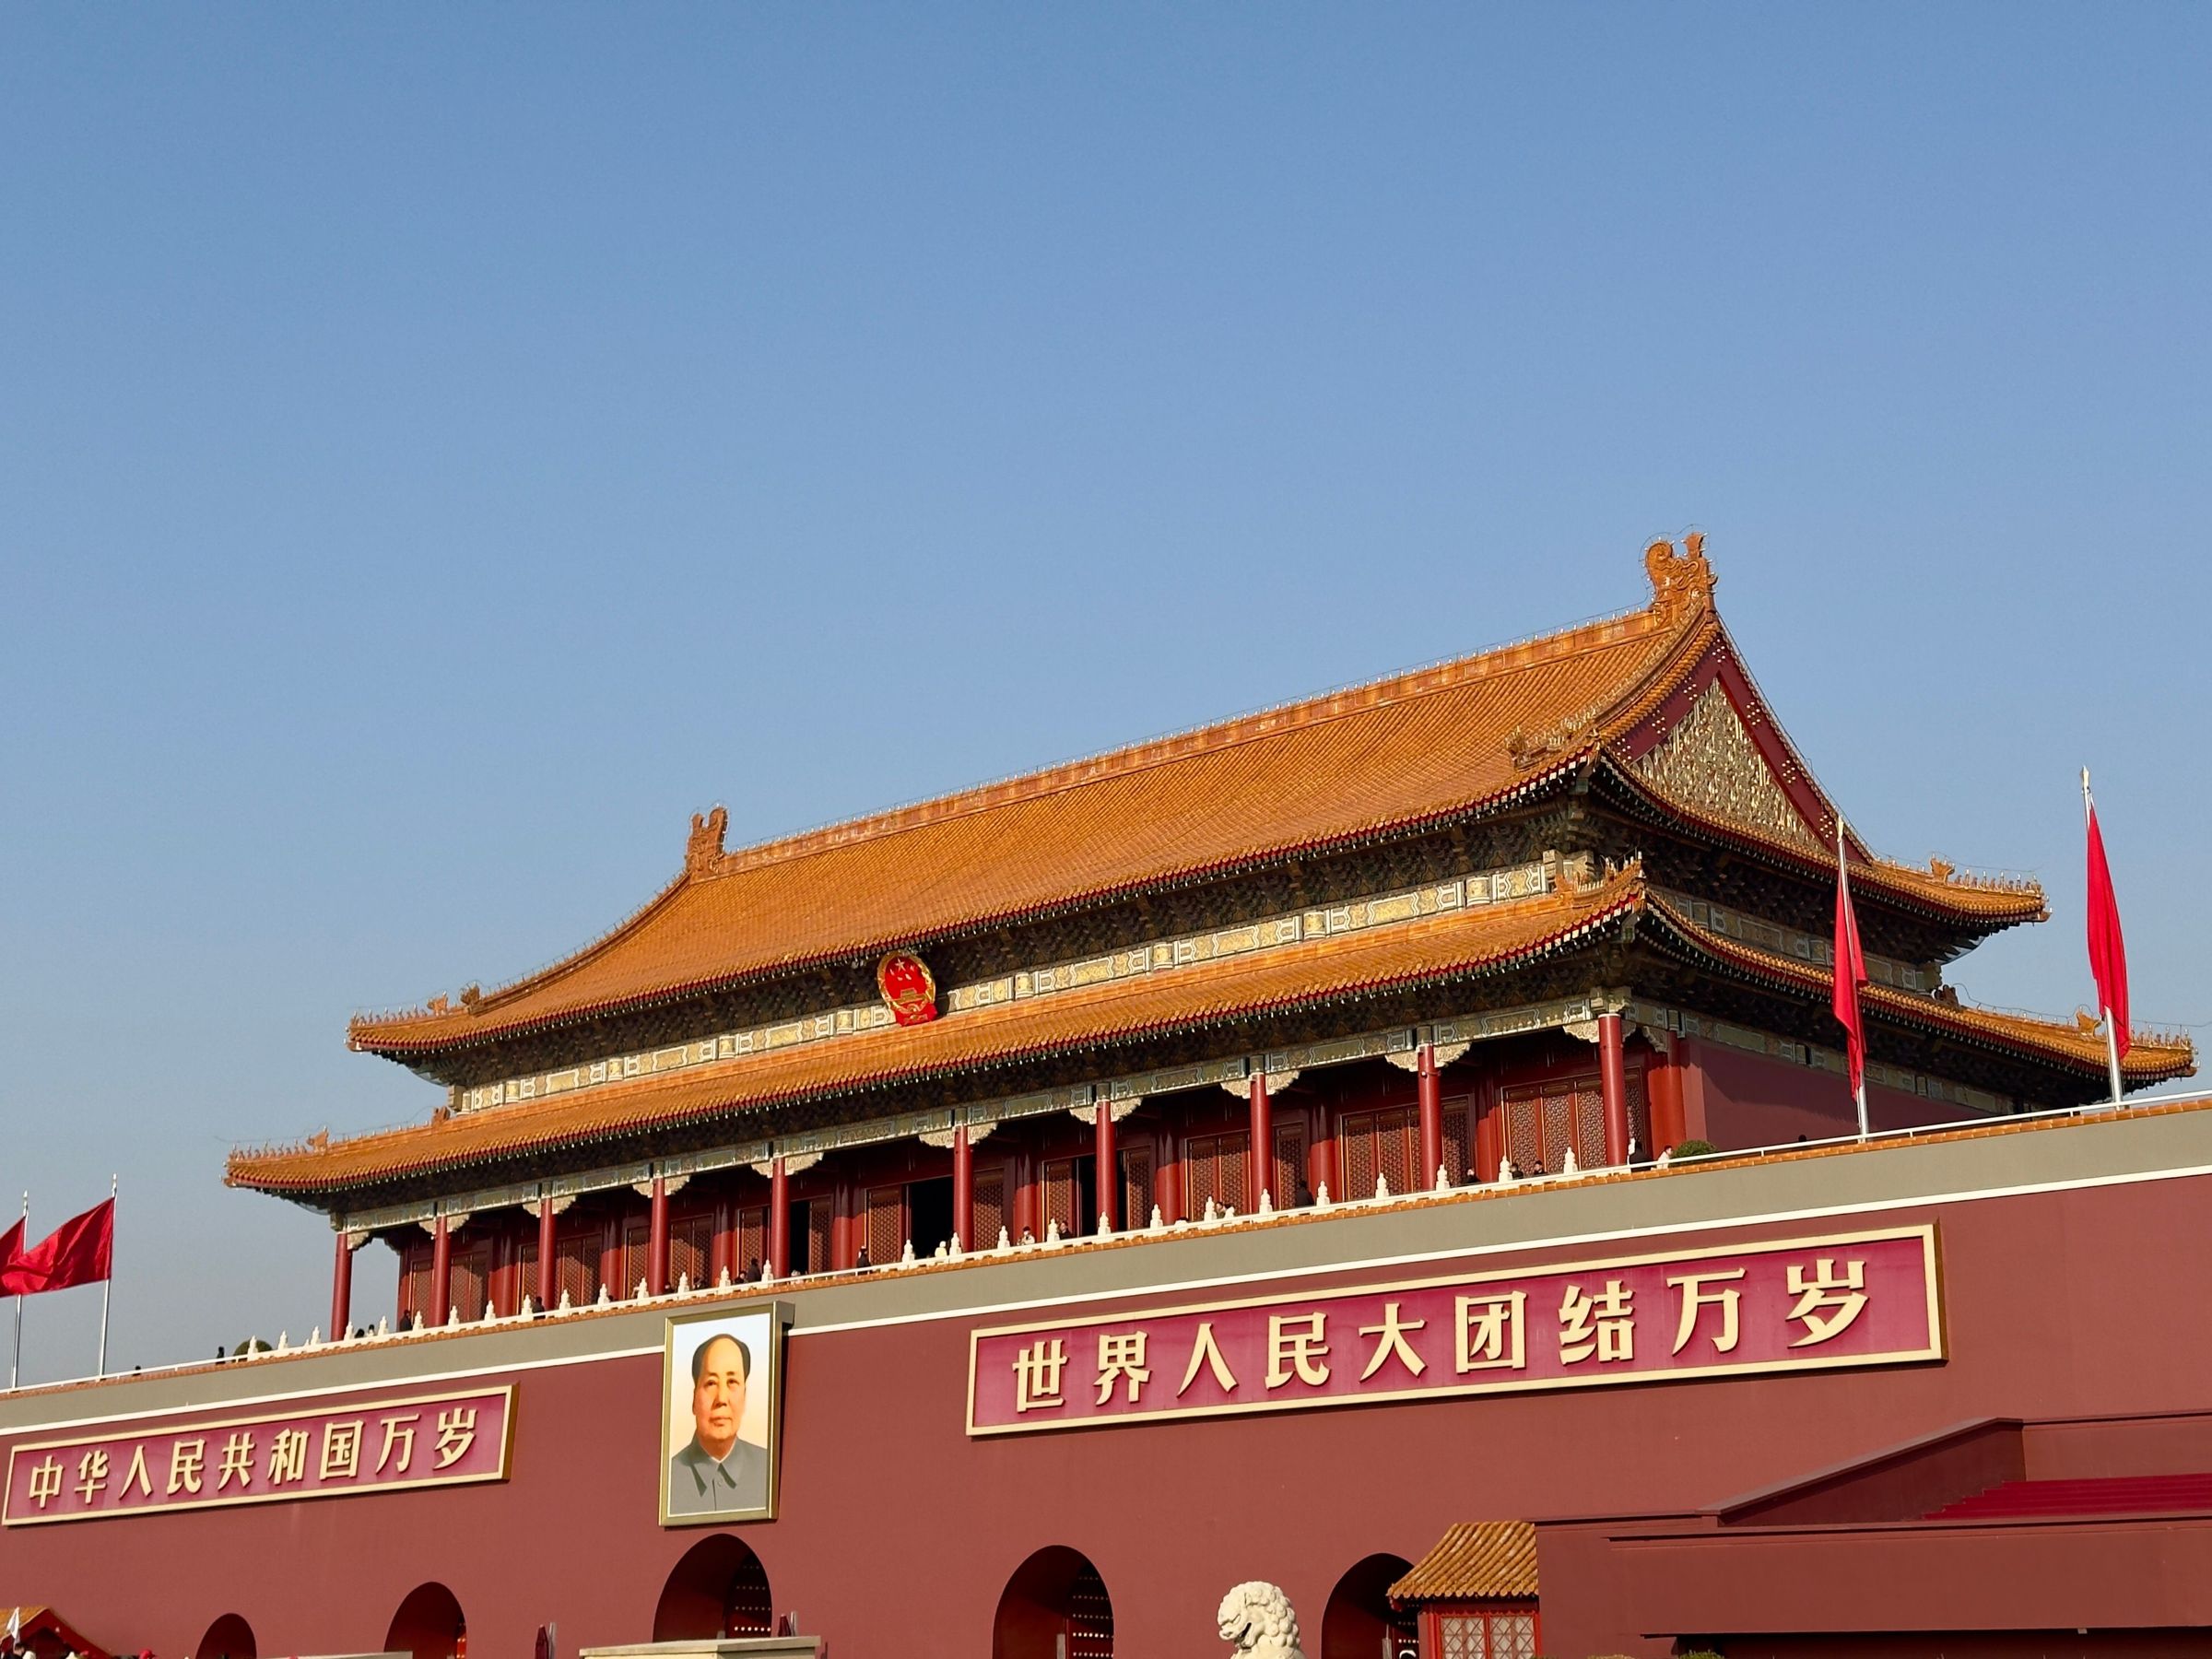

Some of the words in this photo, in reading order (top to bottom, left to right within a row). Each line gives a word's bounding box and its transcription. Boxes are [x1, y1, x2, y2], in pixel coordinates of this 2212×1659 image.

[1013, 1258, 1869, 1413] 世界人民大团结万岁
[29, 1406, 478, 1509] 中华人民共和国万岁
